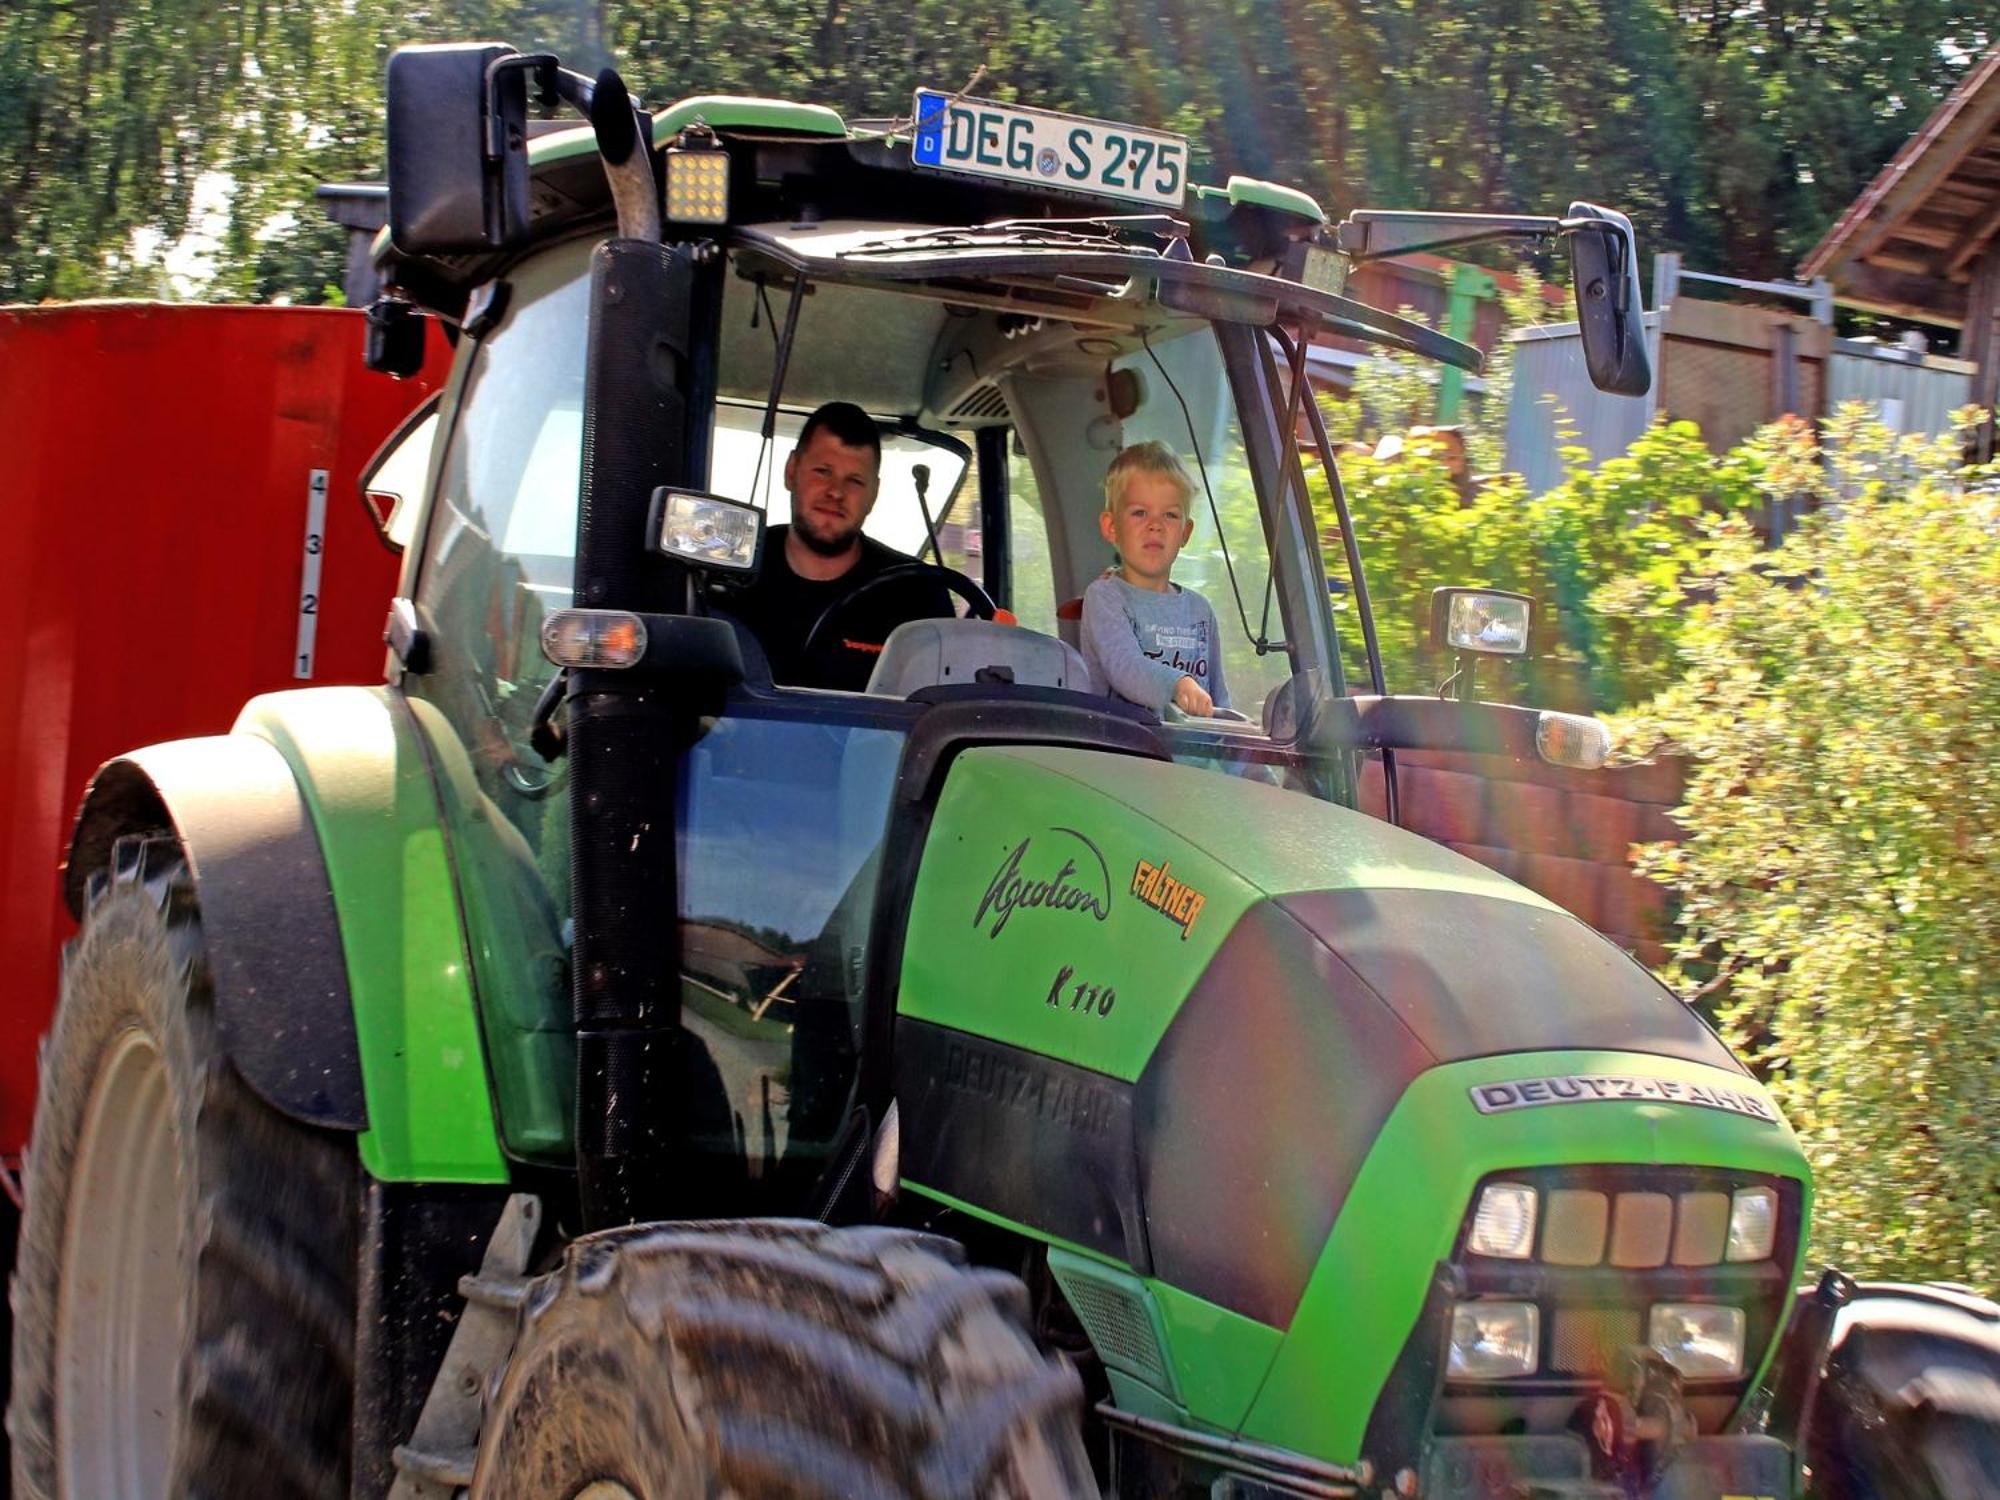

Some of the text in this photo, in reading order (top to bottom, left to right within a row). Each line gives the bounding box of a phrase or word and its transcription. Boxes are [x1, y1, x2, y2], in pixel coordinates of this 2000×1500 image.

[945, 107, 1181, 195] DEG S 275
[310, 476, 326, 495] 4
[306, 533, 321, 555] 3
[302, 593, 317, 615] 2
[299, 653, 310, 673] 1
[1130, 858, 1207, 941] FALTNER
[1046, 965, 1116, 1018] K 110
